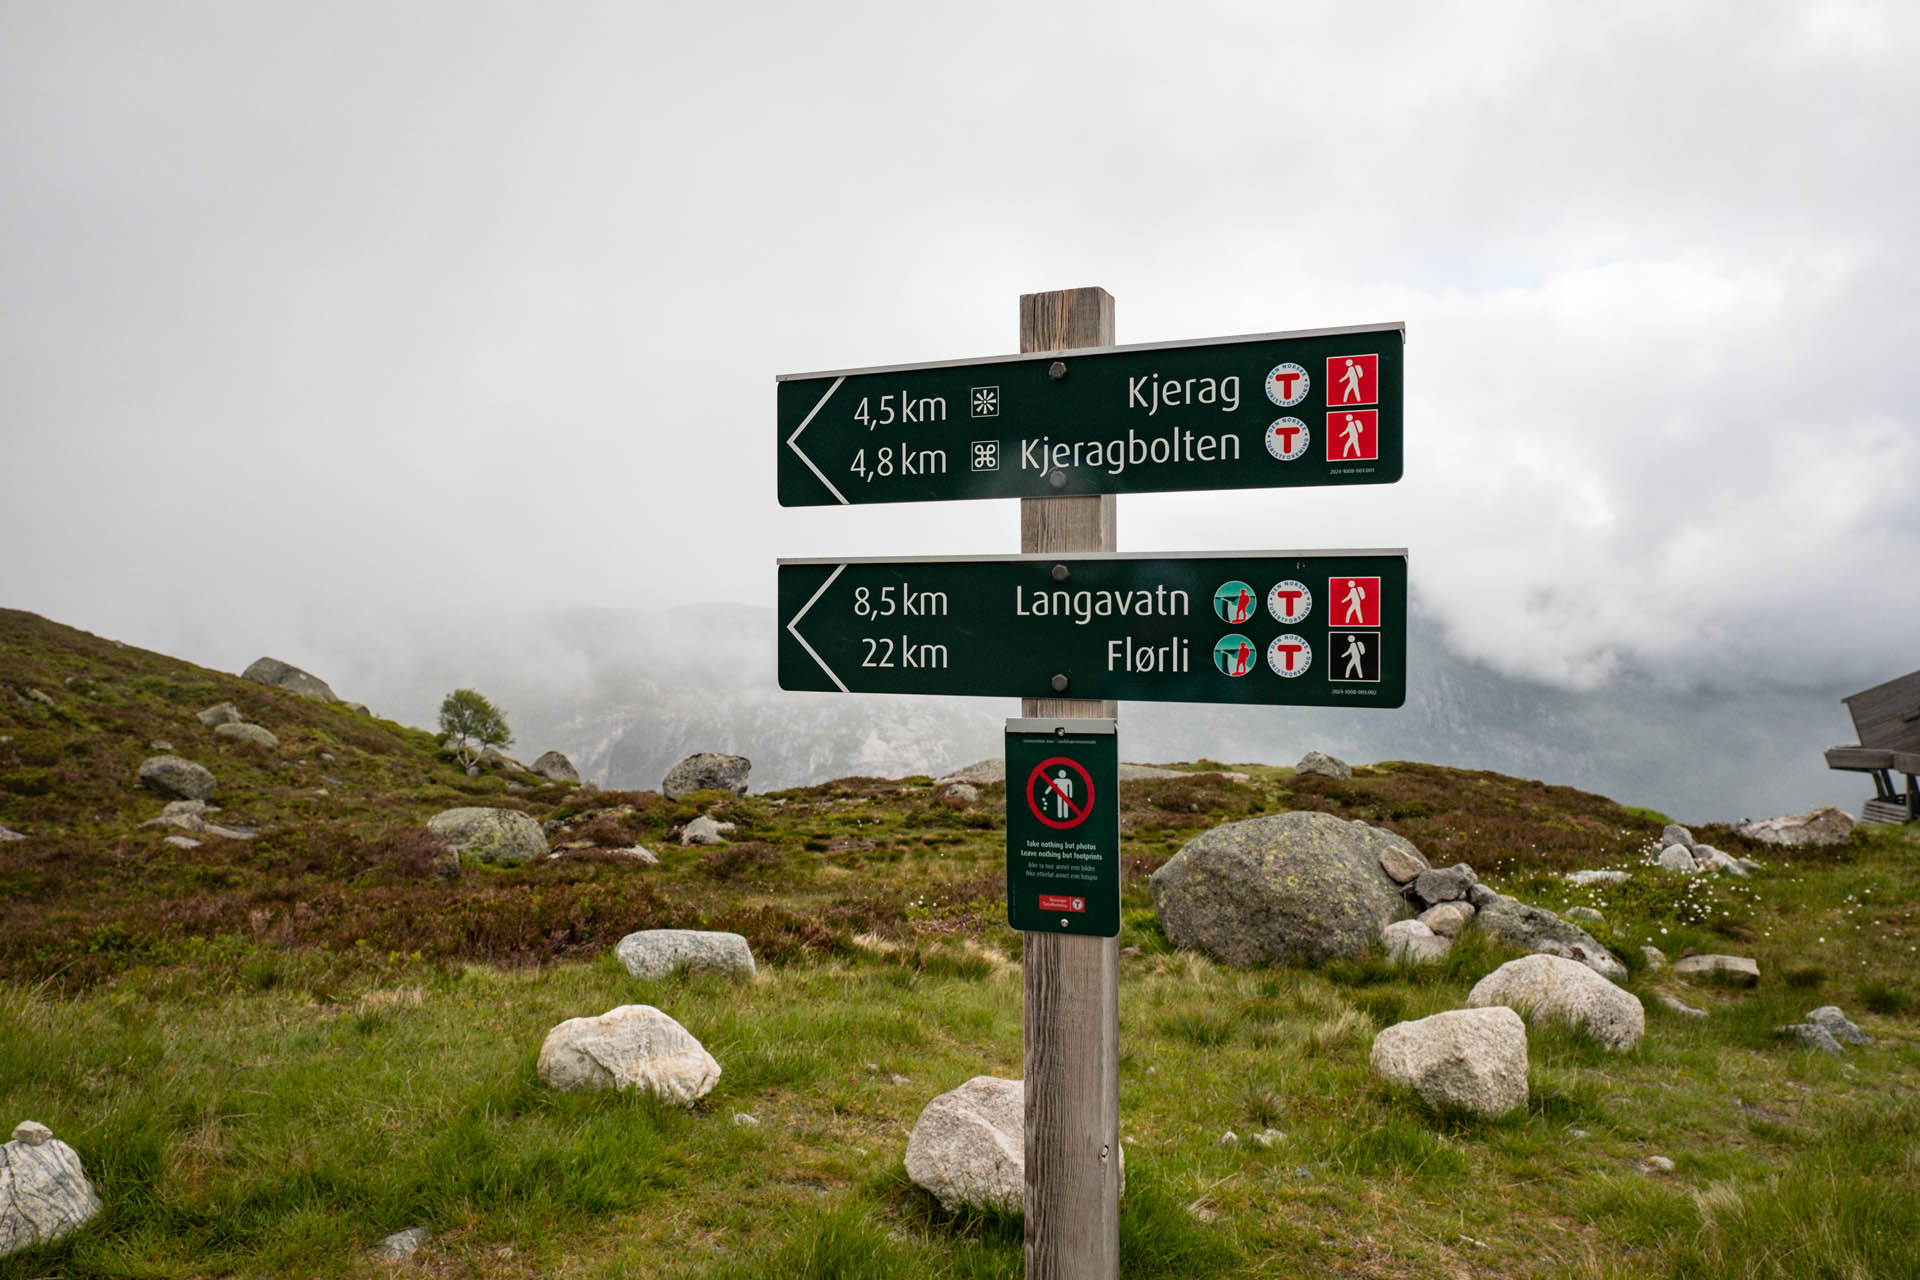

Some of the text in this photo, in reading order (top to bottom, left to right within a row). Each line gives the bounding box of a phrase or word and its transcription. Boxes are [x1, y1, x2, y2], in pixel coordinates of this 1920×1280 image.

[1275, 373, 1300, 400] T
[853, 375, 1240, 431] 4,5 km Kjerag
[1275, 427, 1300, 454] T
[850, 427, 1240, 483] 4,8 km Kjeragbolten
[854, 582, 1189, 624] 8,5 km Langavatn
[1277, 591, 1302, 617] T
[861, 635, 1189, 673] 22 km Flørli
[1277, 644, 1302, 671] T
[1020, 849, 1103, 861] Leave nothing but footprints
[1026, 840, 1097, 851] Take nothing but photos
